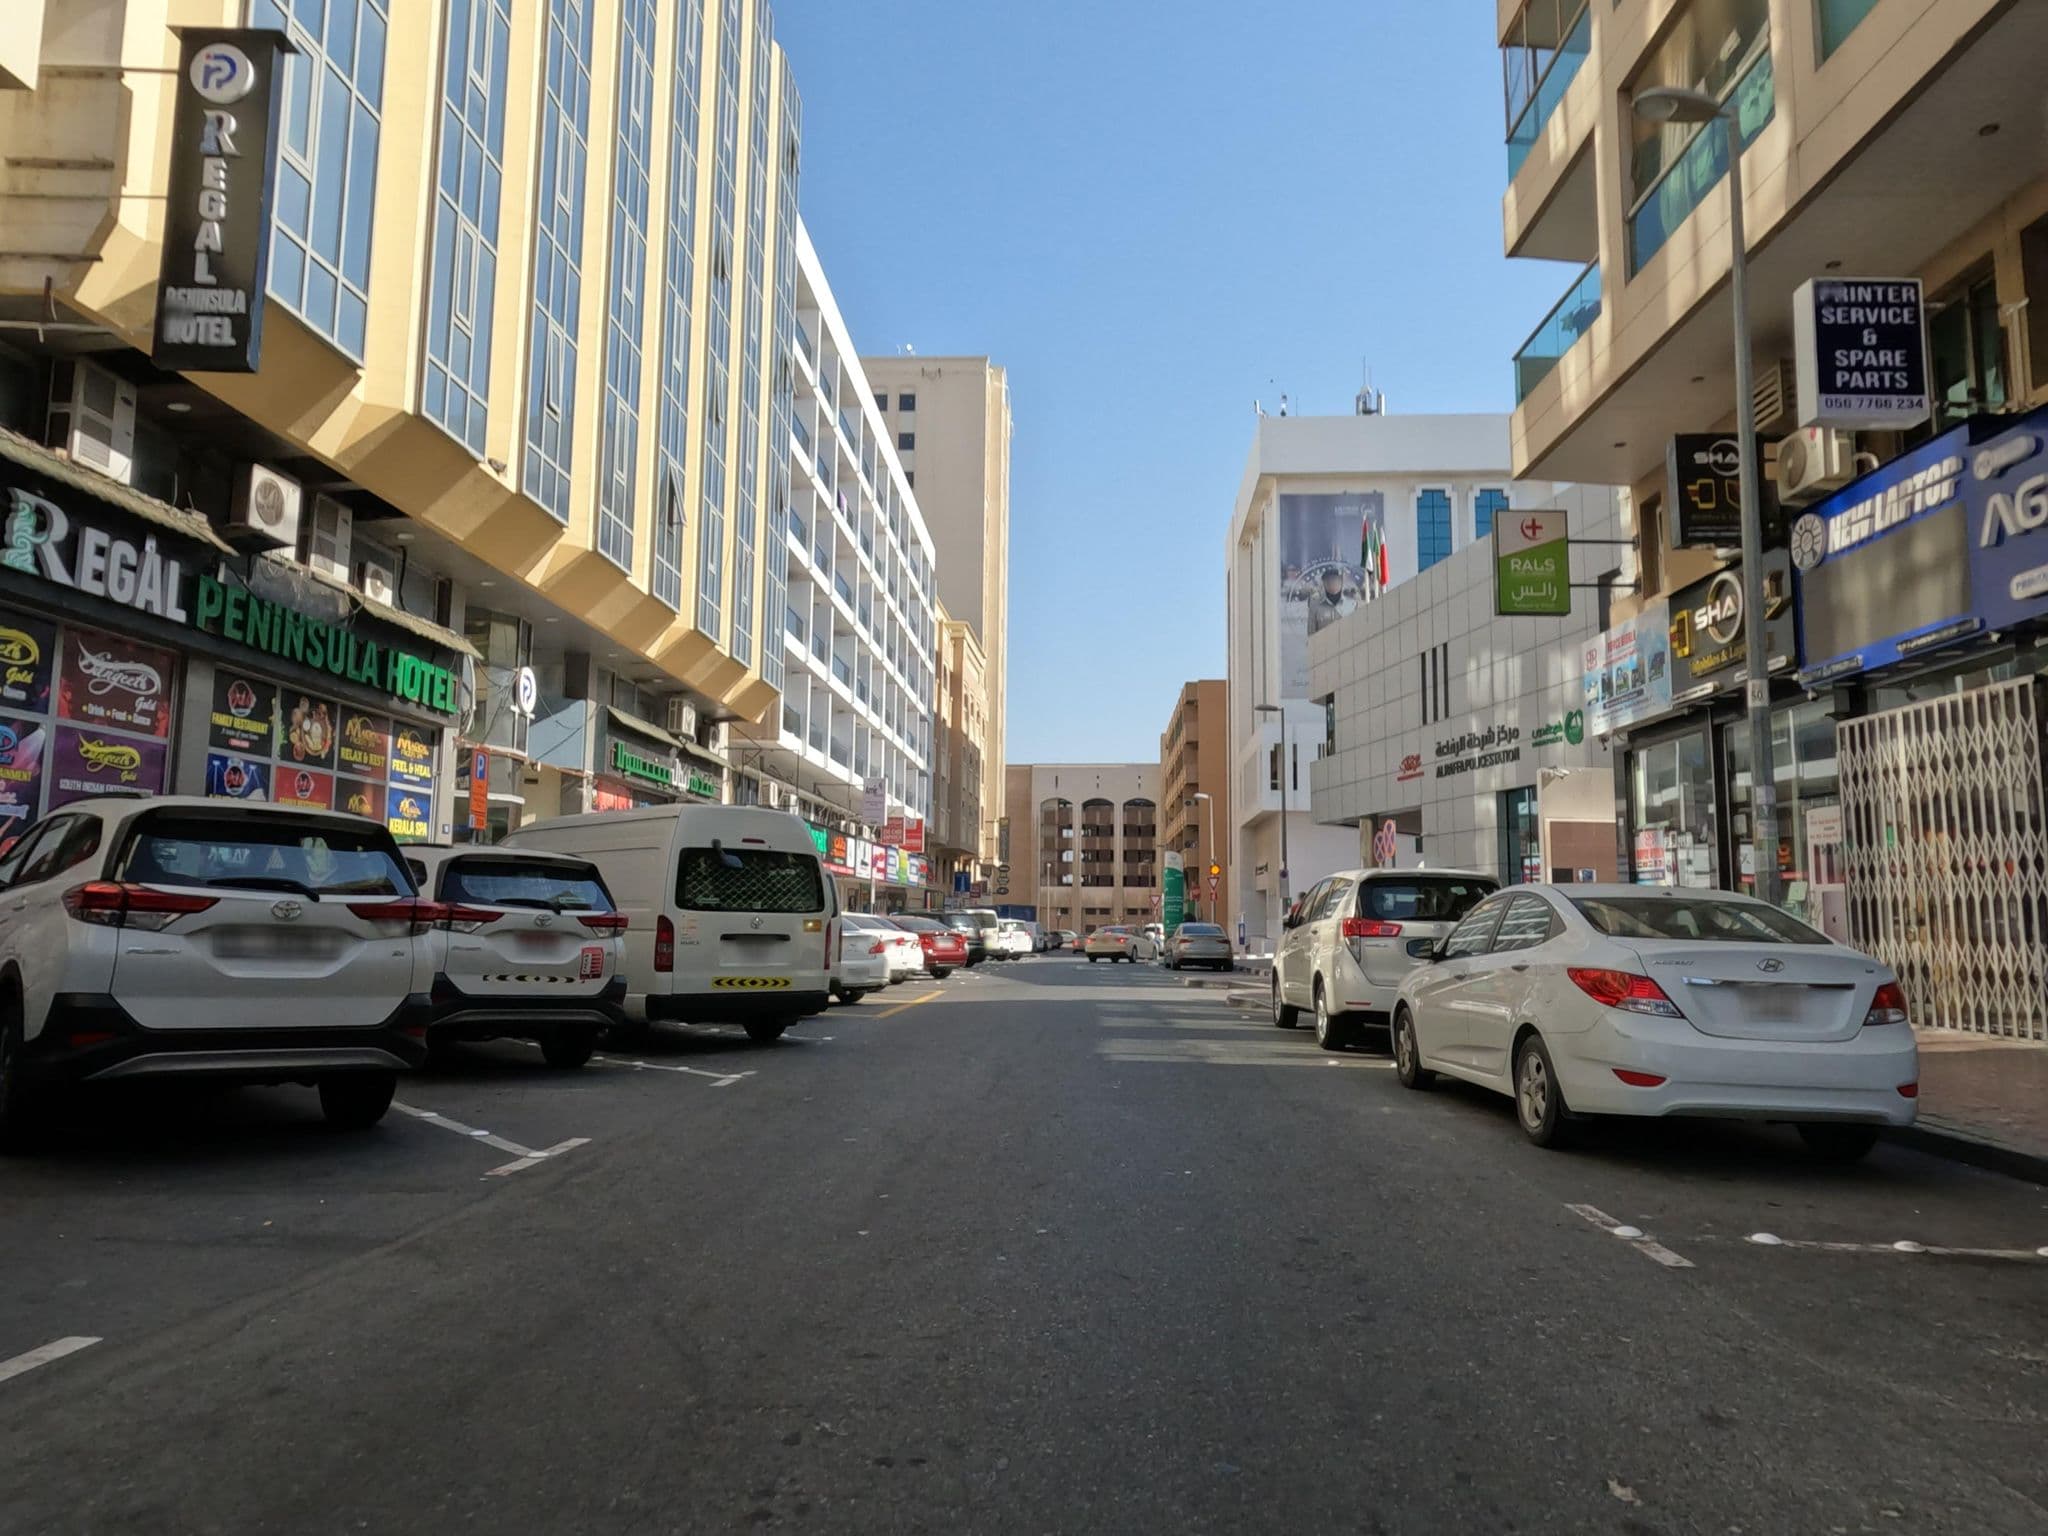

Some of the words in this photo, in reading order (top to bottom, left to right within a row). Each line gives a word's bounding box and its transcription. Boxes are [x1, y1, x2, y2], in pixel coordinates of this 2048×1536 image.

[195, 109, 242, 285] REGAL
[1821, 306, 1916, 325] SERVICE
[1862, 328, 1878, 346] &
[1835, 349, 1908, 367] SPARE
[1836, 370, 1909, 389] PARTS
[1897, 397, 1924, 409] 234
[1827, 499, 1875, 554] NEW
[1874, 456, 1963, 532] LAPTOP
[1510, 558, 1556, 572] RALS
[0, 487, 187, 623] REGAL
[196, 575, 381, 688] PENINSULA
[386, 648, 460, 715] HOTEL
[391, 759, 408, 774] FEEL
[414, 764, 432, 778] HEAL
[388, 817, 415, 836] KERALA
[415, 822, 428, 837] SPA
